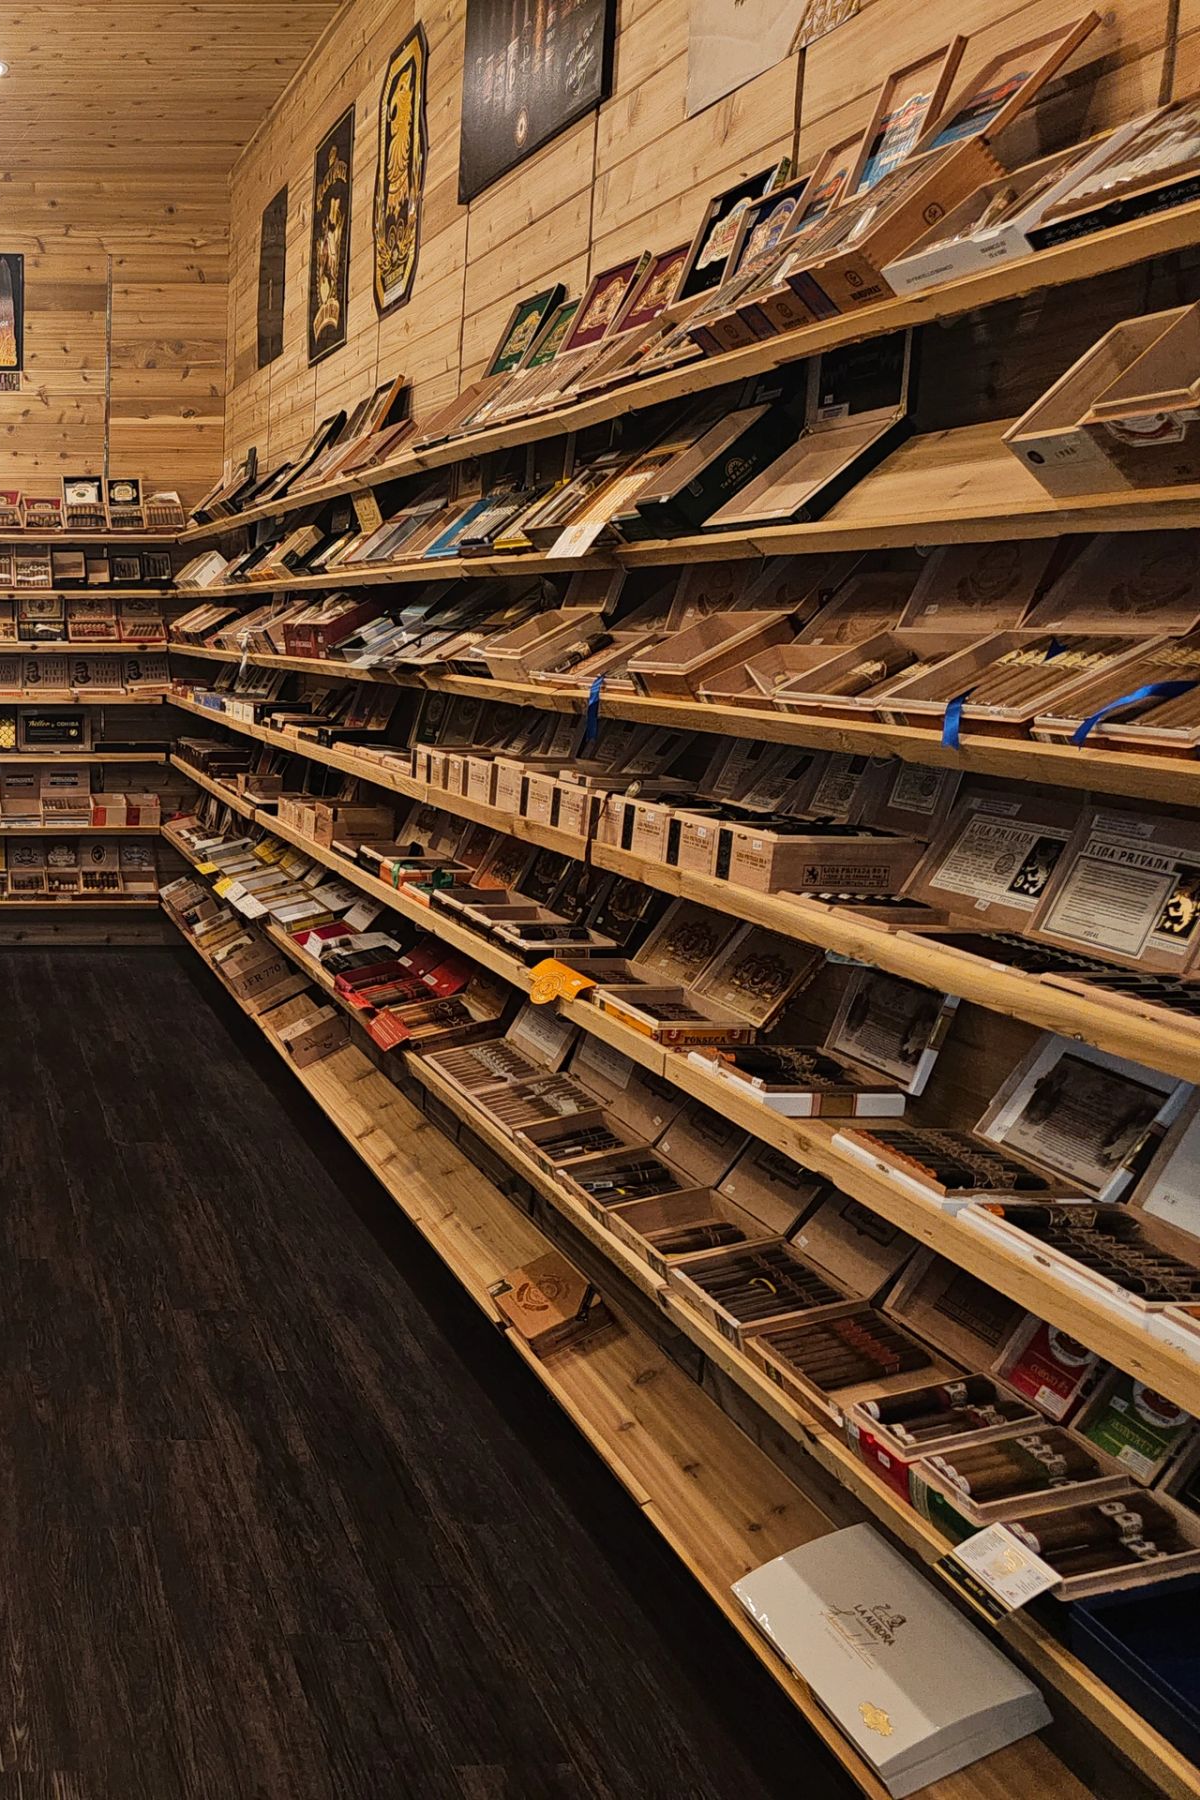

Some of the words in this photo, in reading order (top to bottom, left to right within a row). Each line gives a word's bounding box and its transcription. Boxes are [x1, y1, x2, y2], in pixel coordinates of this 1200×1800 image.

[970, 823, 992, 837] LIGA
[991, 827, 1035, 844] PRIVADA
[1089, 844, 1116, 860] LIGA
[1118, 850, 1170, 871] PRIVADA
[1014, 875, 1025, 888] 9
[242, 971, 264, 990] JFR
[264, 963, 281, 978] 770
[684, 1036, 726, 1044] FONSECA
[853, 1604, 867, 1617] LA
[863, 1616, 896, 1647] AURORA
